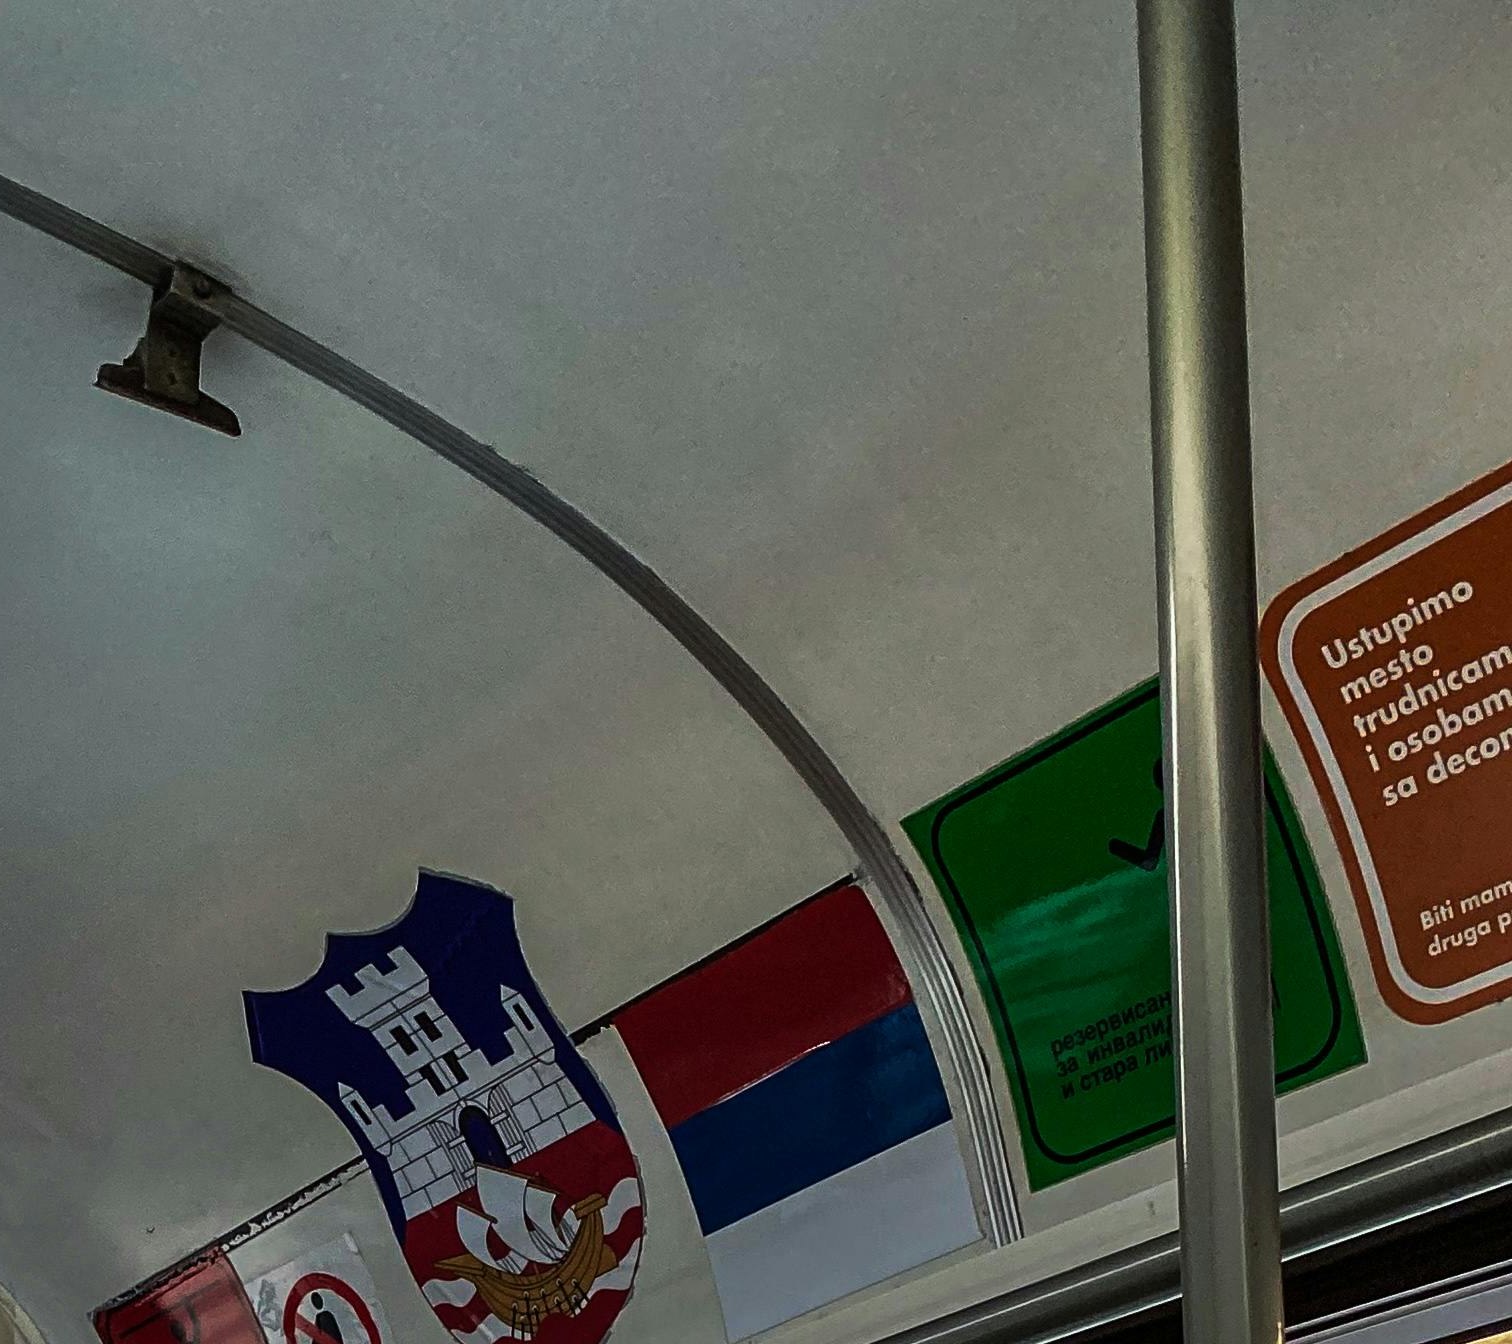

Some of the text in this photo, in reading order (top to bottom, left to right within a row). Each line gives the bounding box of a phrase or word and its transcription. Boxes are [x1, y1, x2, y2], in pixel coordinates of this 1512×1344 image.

[1321, 581, 1474, 669] Ustupimo
[1340, 644, 1434, 705] mesto
[1364, 744, 1381, 773] i
[1382, 775, 1419, 807] sa
[1419, 899, 1455, 932] Biti
[1427, 919, 1492, 957] druga
[1055, 1056, 1080, 1078] за
[1060, 1081, 1076, 1100] и
[1079, 1055, 1140, 1092] стара
